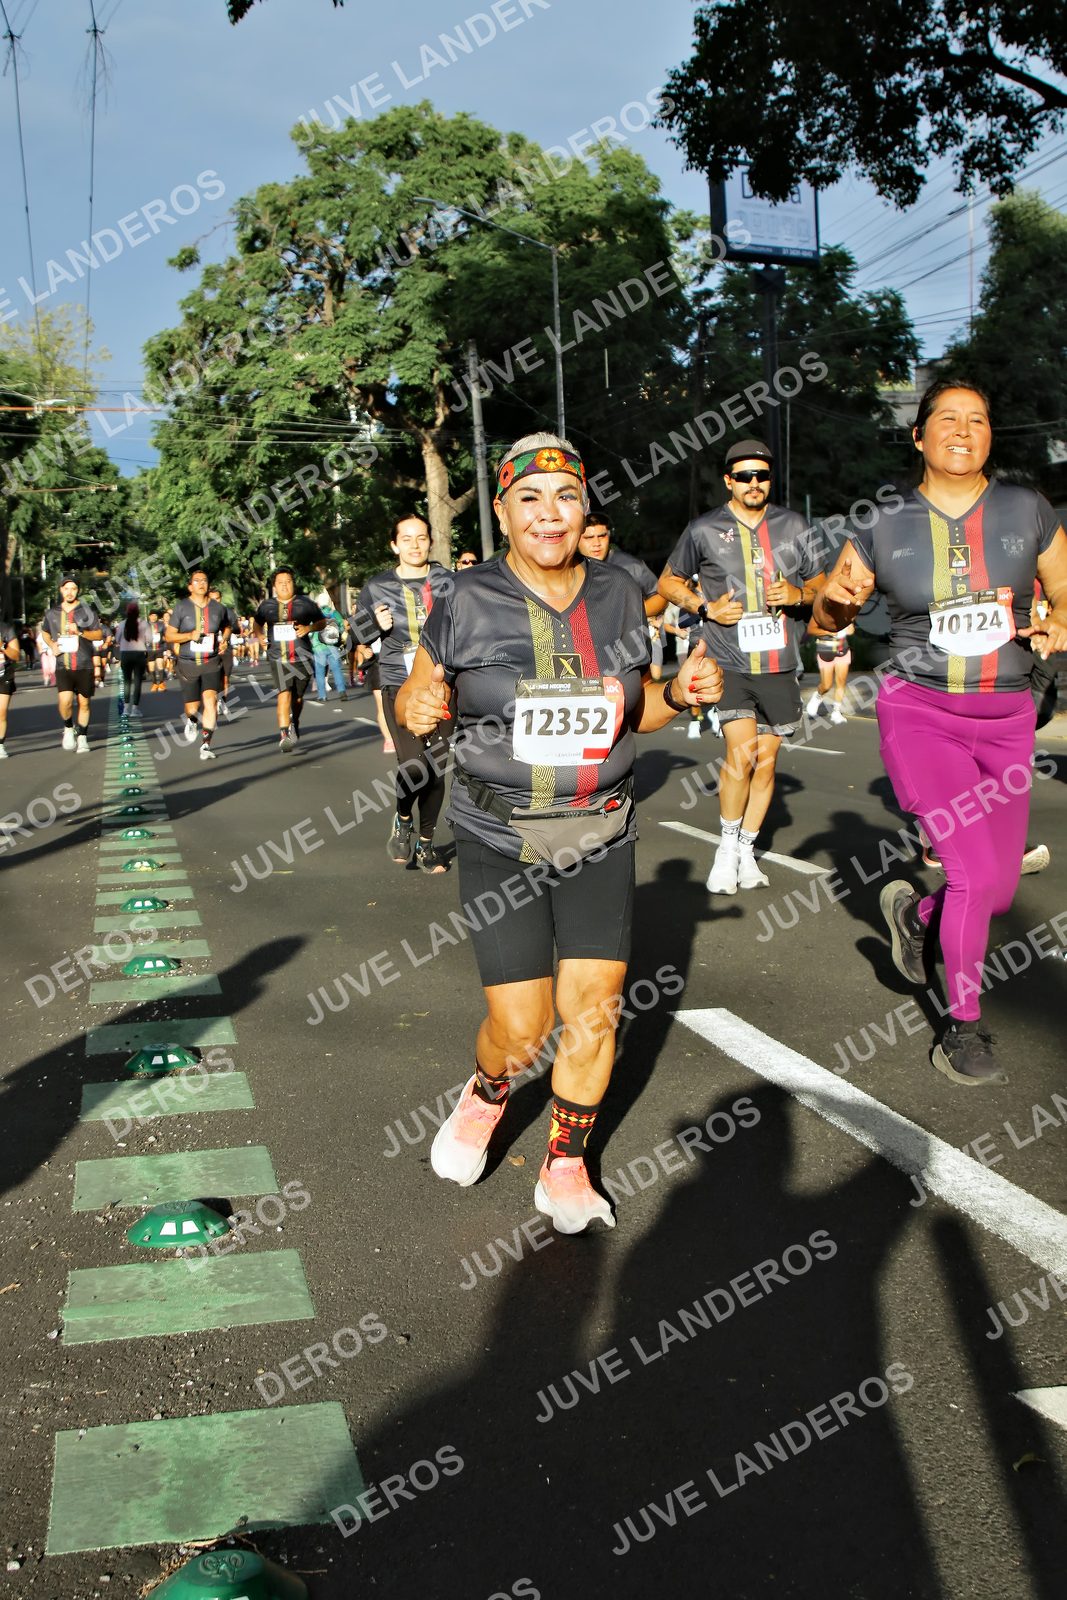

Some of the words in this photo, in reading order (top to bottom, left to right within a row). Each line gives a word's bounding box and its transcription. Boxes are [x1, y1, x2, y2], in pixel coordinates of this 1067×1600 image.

[741, 621, 781, 638] 11158
[936, 609, 1003, 635] 10124
[521, 707, 608, 736] 12352
